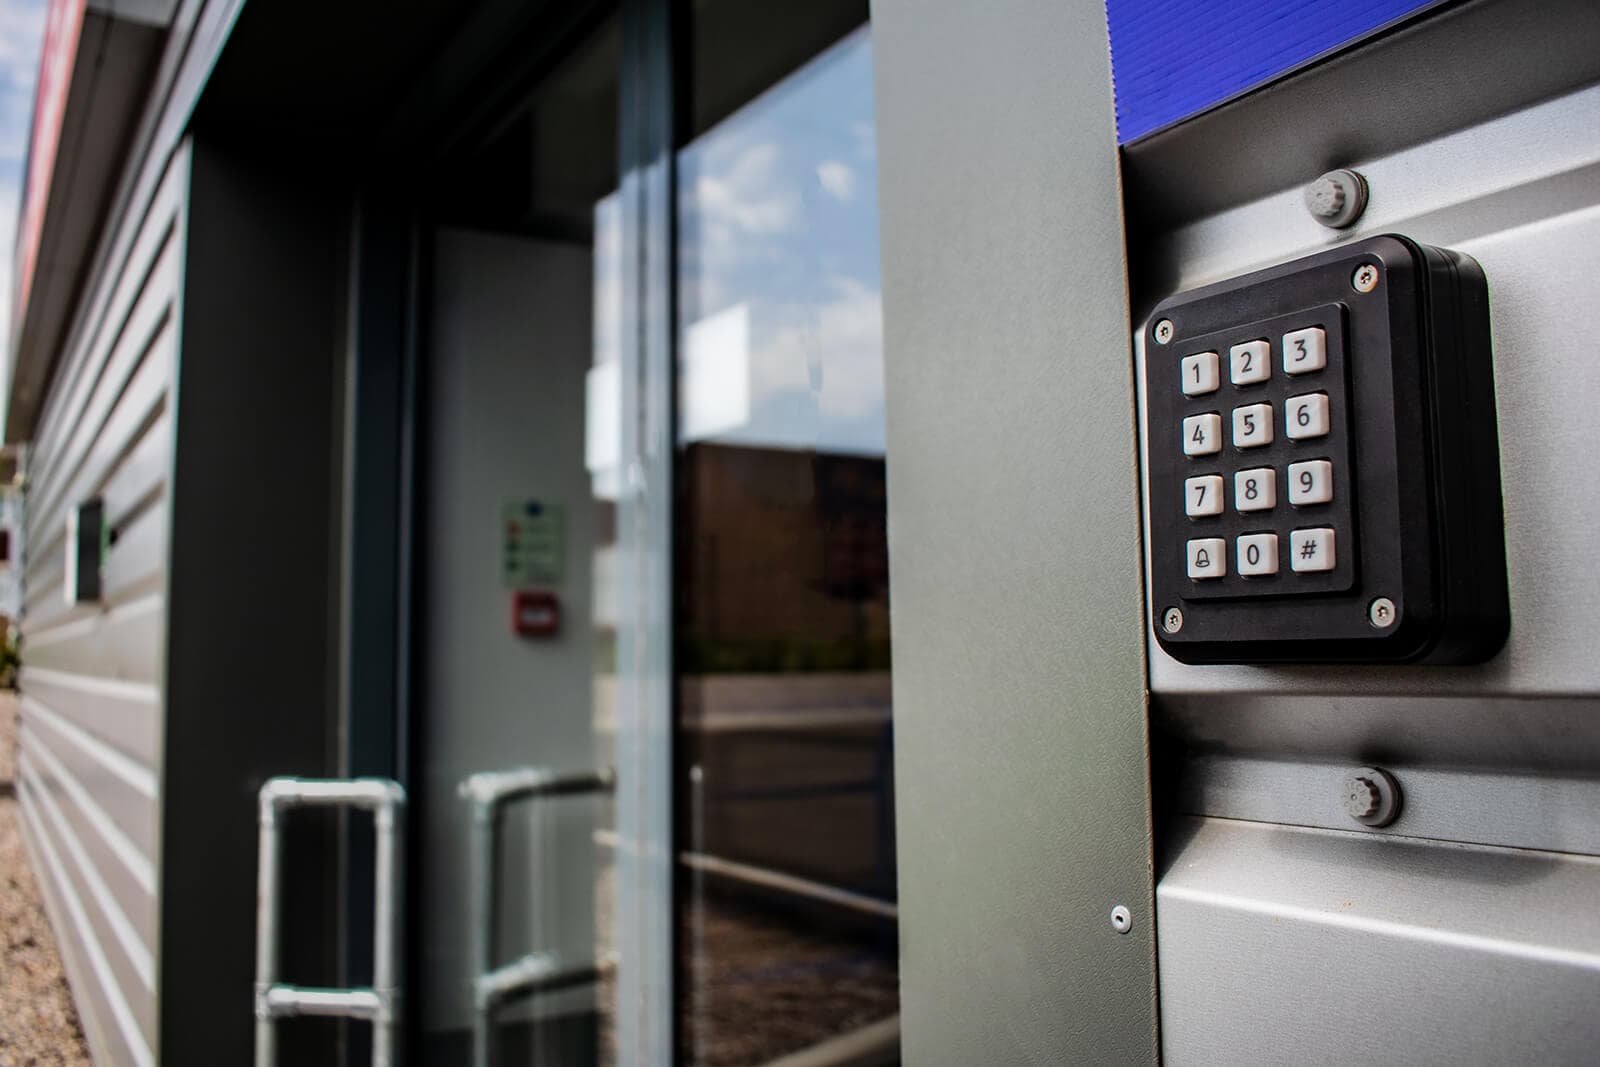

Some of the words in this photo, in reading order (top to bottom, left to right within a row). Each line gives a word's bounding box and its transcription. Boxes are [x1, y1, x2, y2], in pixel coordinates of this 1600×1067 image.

[1192, 363, 1200, 384] 1
[1240, 351, 1253, 374] 2
[1294, 339, 1307, 361] 3
[1192, 424, 1205, 445] 4
[1243, 413, 1256, 436] 5
[1296, 404, 1310, 427] 6
[1195, 485, 1207, 507] 7
[1245, 478, 1258, 501] 8
[1300, 471, 1313, 493] 9
[1246, 543, 1260, 566] 0
[1300, 540, 1317, 560] #
